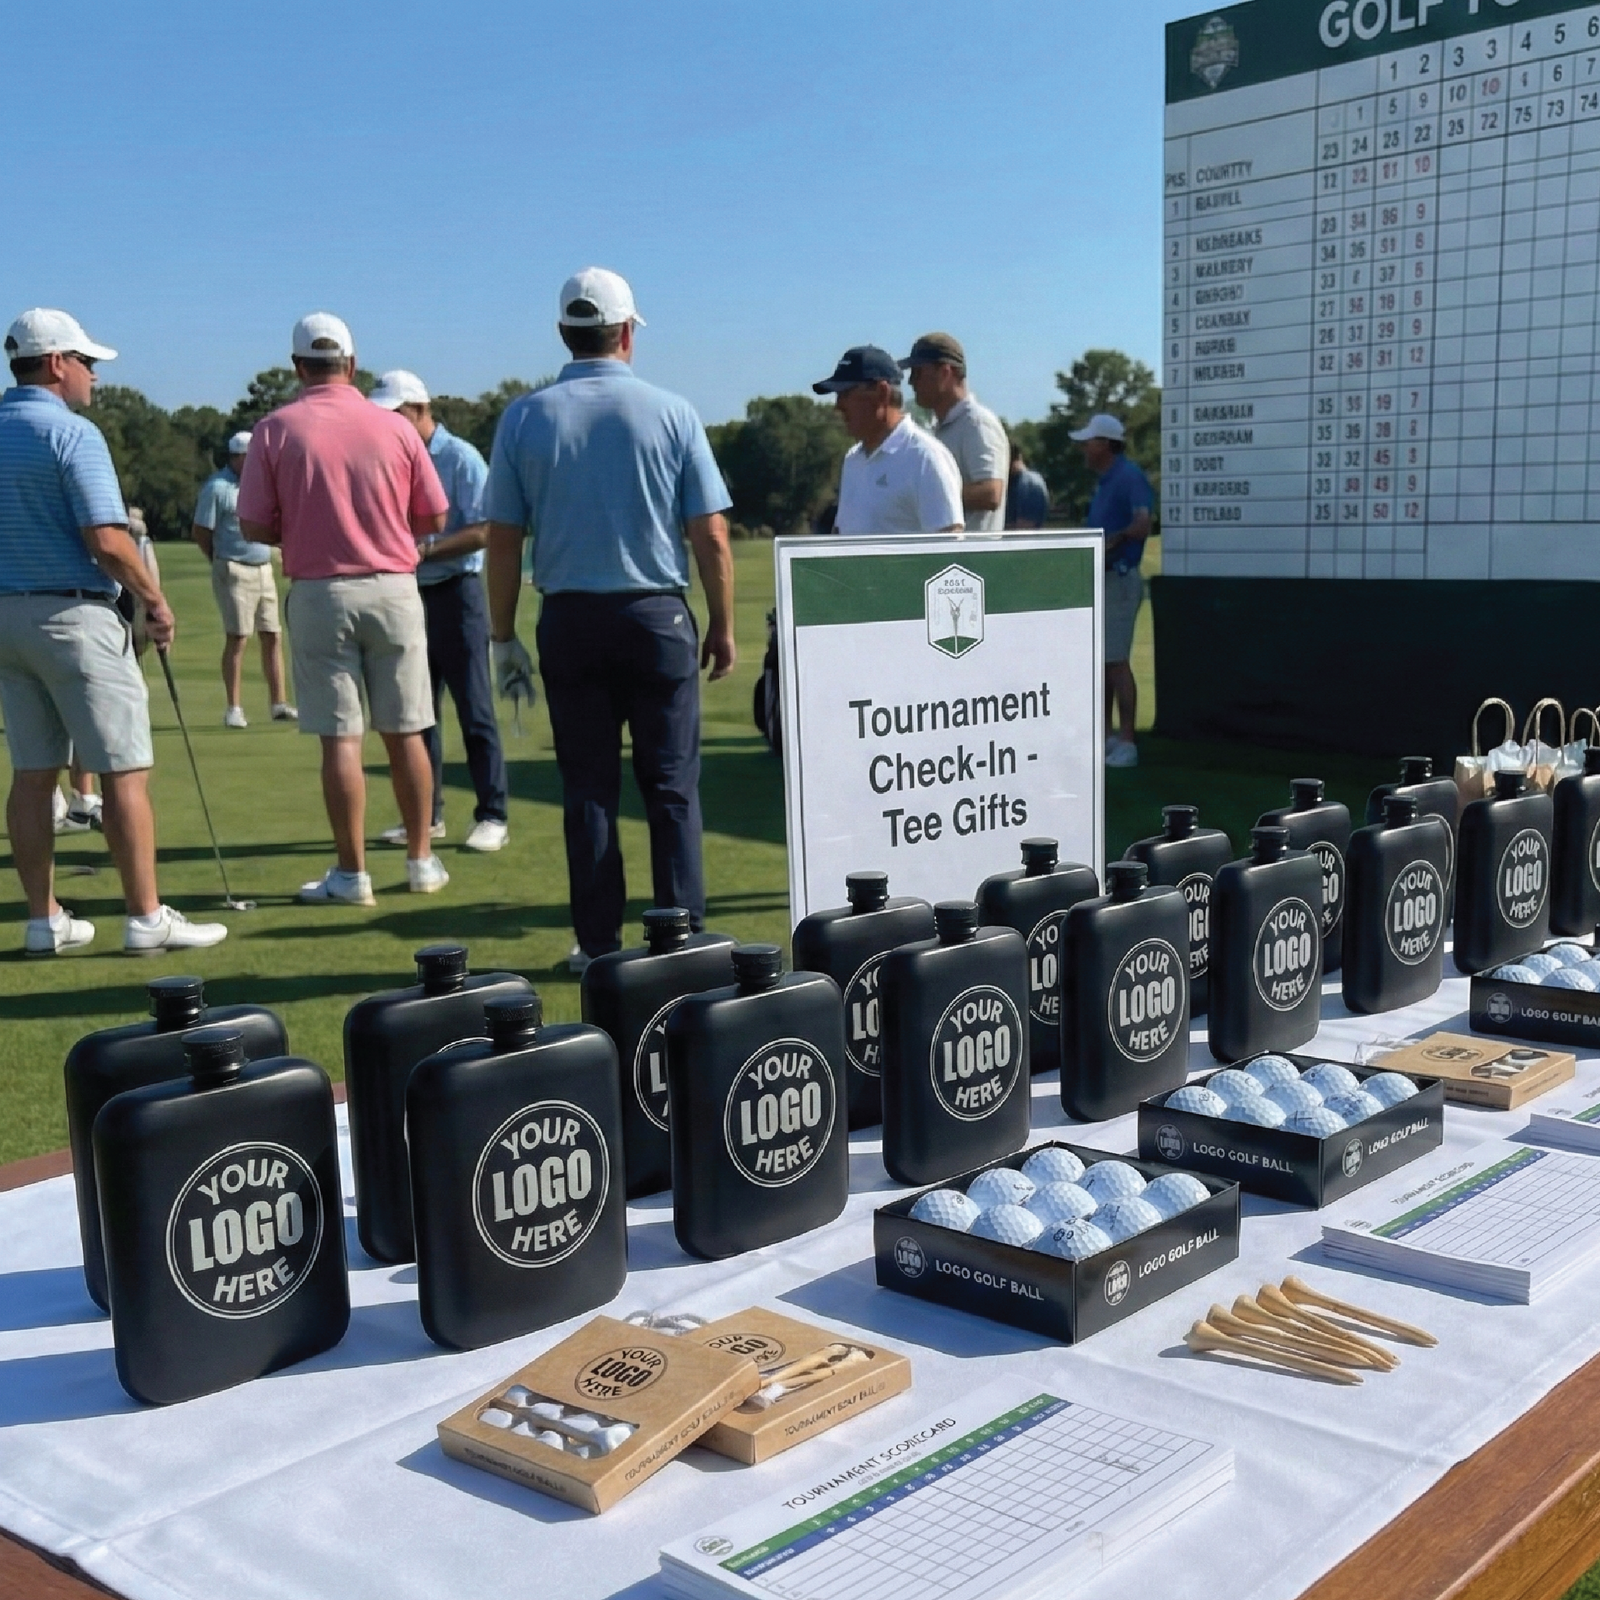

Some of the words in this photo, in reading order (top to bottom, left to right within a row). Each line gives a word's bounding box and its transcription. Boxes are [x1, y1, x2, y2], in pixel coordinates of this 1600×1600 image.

[1319, 0, 1443, 48] GOLF
[1390, 61, 1397, 81] 1
[1419, 54, 1430, 74] 2
[1453, 46, 1464, 67] 3
[1486, 38, 1497, 59] 3
[1520, 30, 1531, 51] 4
[1554, 23, 1566, 44] 5
[1588, 16, 1599, 37] 6
[1419, 92, 1428, 109] 9
[1449, 84, 1467, 102] 10
[1553, 64, 1562, 82] 6
[1587, 57, 1596, 75] 7
[1481, 112, 1498, 131] 72
[1515, 106, 1532, 124] 75
[1547, 99, 1564, 118] 73
[1580, 92, 1598, 112] 74
[1410, 391, 1419, 408] 7
[848, 682, 1051, 739] Tournament
[869, 740, 1016, 794] Check-In
[882, 808, 943, 848] Tee
[952, 792, 1028, 836] Gifts
[1320, 850, 1335, 872] UR
[1511, 837, 1541, 864] YOUR
[1184, 883, 1210, 904] OUR
[1505, 859, 1543, 898] LOGO
[1270, 909, 1307, 937] YOUR
[1394, 892, 1436, 933] LOGO
[1036, 925, 1058, 951] YO
[1264, 932, 1311, 978] LOGO
[1031, 953, 1060, 991] LO
[1124, 951, 1170, 982] YOUR
[852, 998, 880, 1041] LO
[949, 998, 1004, 1033] YOUR
[1039, 994, 1059, 1015] HE
[1119, 975, 1175, 1028] LOGO
[943, 1024, 1011, 1083] LOGO
[1129, 1019, 1169, 1050] HERE
[748, 1052, 813, 1090] YOUR
[954, 1074, 1003, 1109] HERE
[740, 1081, 822, 1146] LOGO
[500, 1117, 581, 1160] YOUR
[755, 1135, 814, 1174] HERE
[1193, 1142, 1225, 1158] LOGO
[1228, 1150, 1259, 1165] GOLF
[1262, 1156, 1294, 1173] BALL
[197, 1158, 289, 1206] YOUR
[492, 1149, 592, 1222] LOGO
[188, 1191, 304, 1273] LOGO
[511, 1208, 583, 1252] HERE
[1138, 1254, 1166, 1278] LOGO
[1168, 1239, 1194, 1262] GOLF
[1195, 1227, 1220, 1250] BALL
[212, 1256, 295, 1303] HERE
[935, 1259, 971, 1279] LOGO
[973, 1270, 1007, 1289] GOLF
[1010, 1280, 1045, 1301] BALL
[590, 1357, 653, 1387] LOGO
[621, 1349, 662, 1368] YOUR
